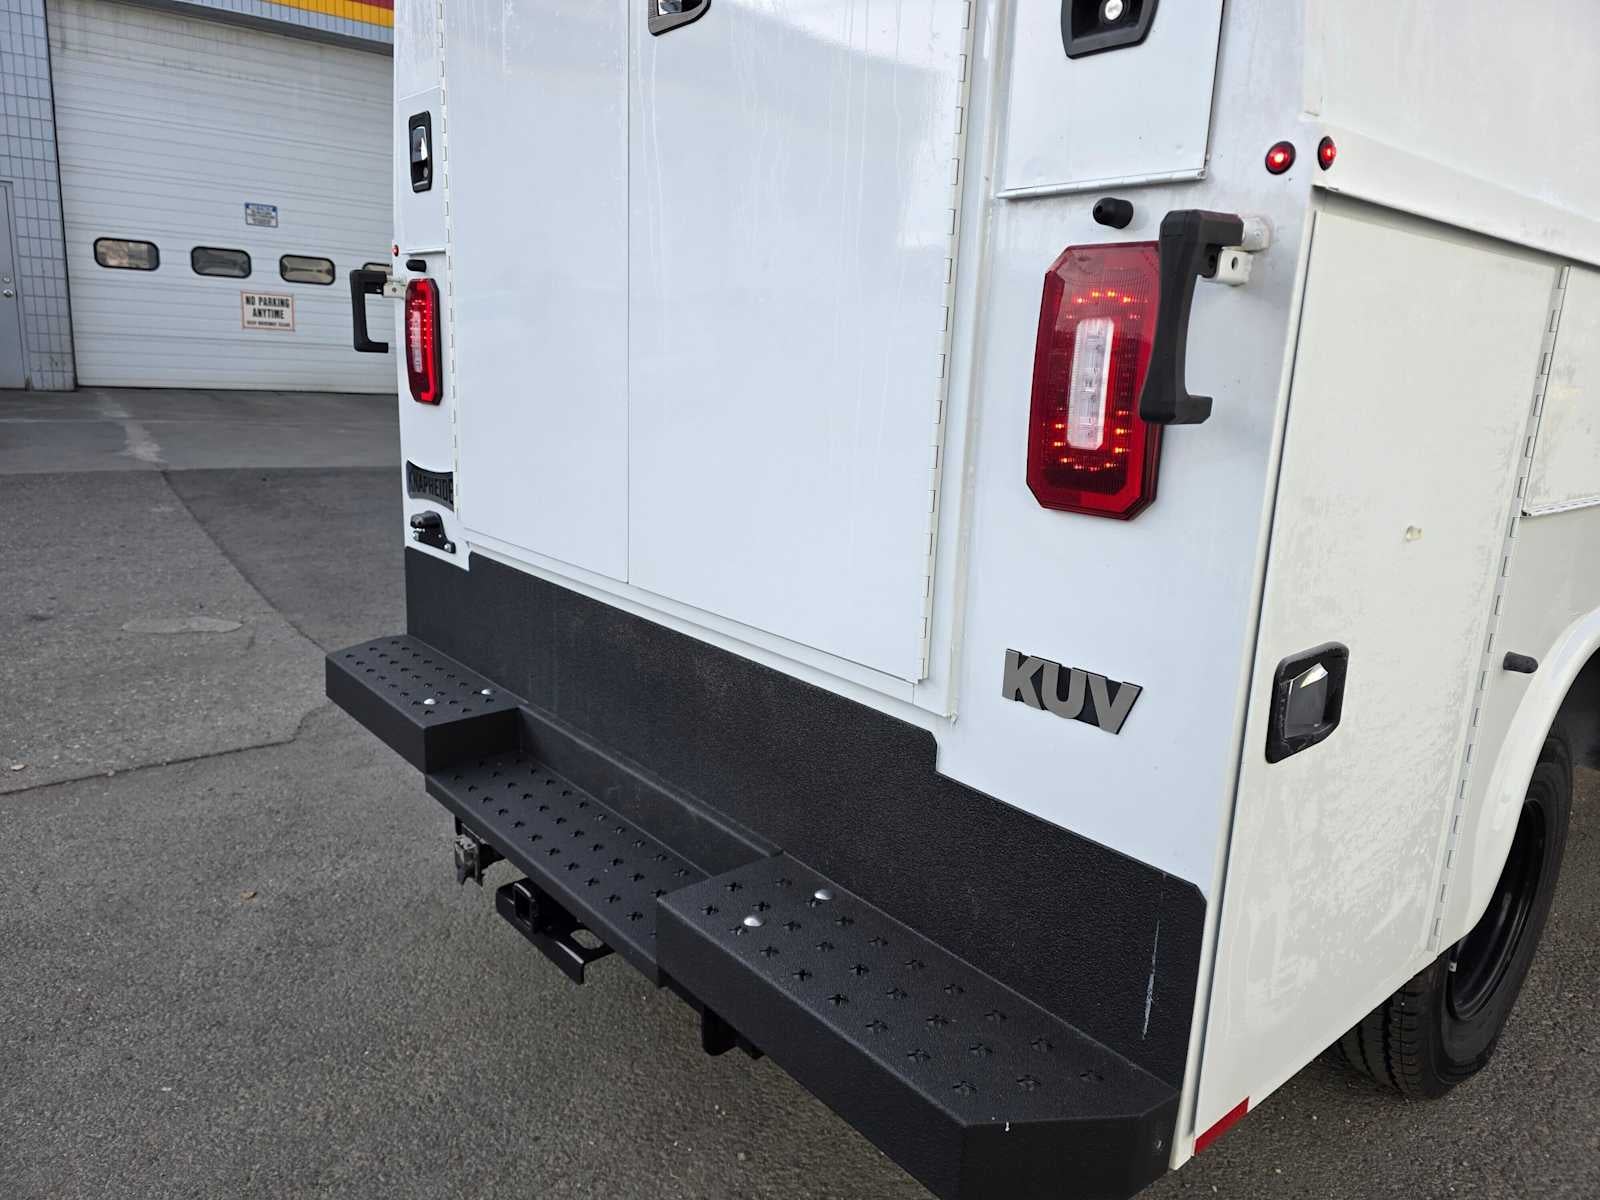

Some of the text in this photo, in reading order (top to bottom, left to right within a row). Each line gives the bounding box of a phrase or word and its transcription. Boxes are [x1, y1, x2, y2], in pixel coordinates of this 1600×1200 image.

[245, 295, 290, 308] NO PARKING
[252, 307, 285, 320] ANYTIME
[1002, 648, 1143, 735] KUV
